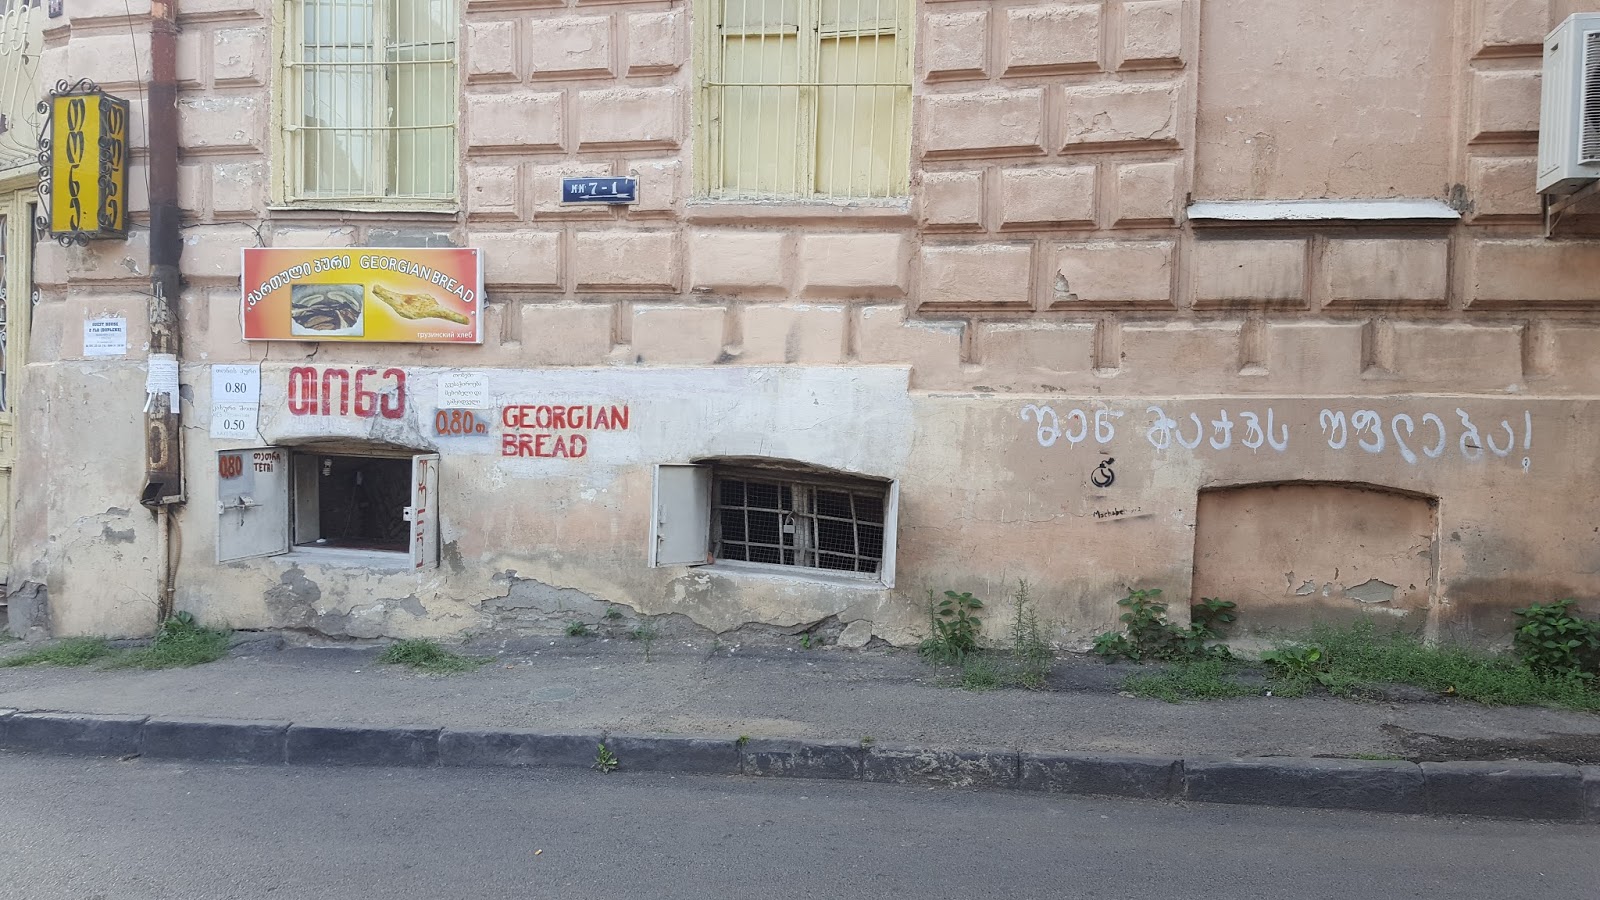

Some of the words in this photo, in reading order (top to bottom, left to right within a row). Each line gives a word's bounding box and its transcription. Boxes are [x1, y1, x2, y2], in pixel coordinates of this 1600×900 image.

[247, 262, 312, 306] ქართული
[313, 254, 351, 273] პური
[360, 255, 432, 280] GEORGIAN
[431, 270, 475, 303] BREAD
[417, 331, 455, 339] грузинский
[457, 331, 473, 339] хлеб
[225, 382, 247, 394] 0.80
[288, 366, 406, 419] თონე
[223, 419, 245, 431] 0.50
[502, 405, 630, 430] GEORGIAN
[1020, 404, 1124, 447] შენ
[502, 433, 588, 458] BREAD
